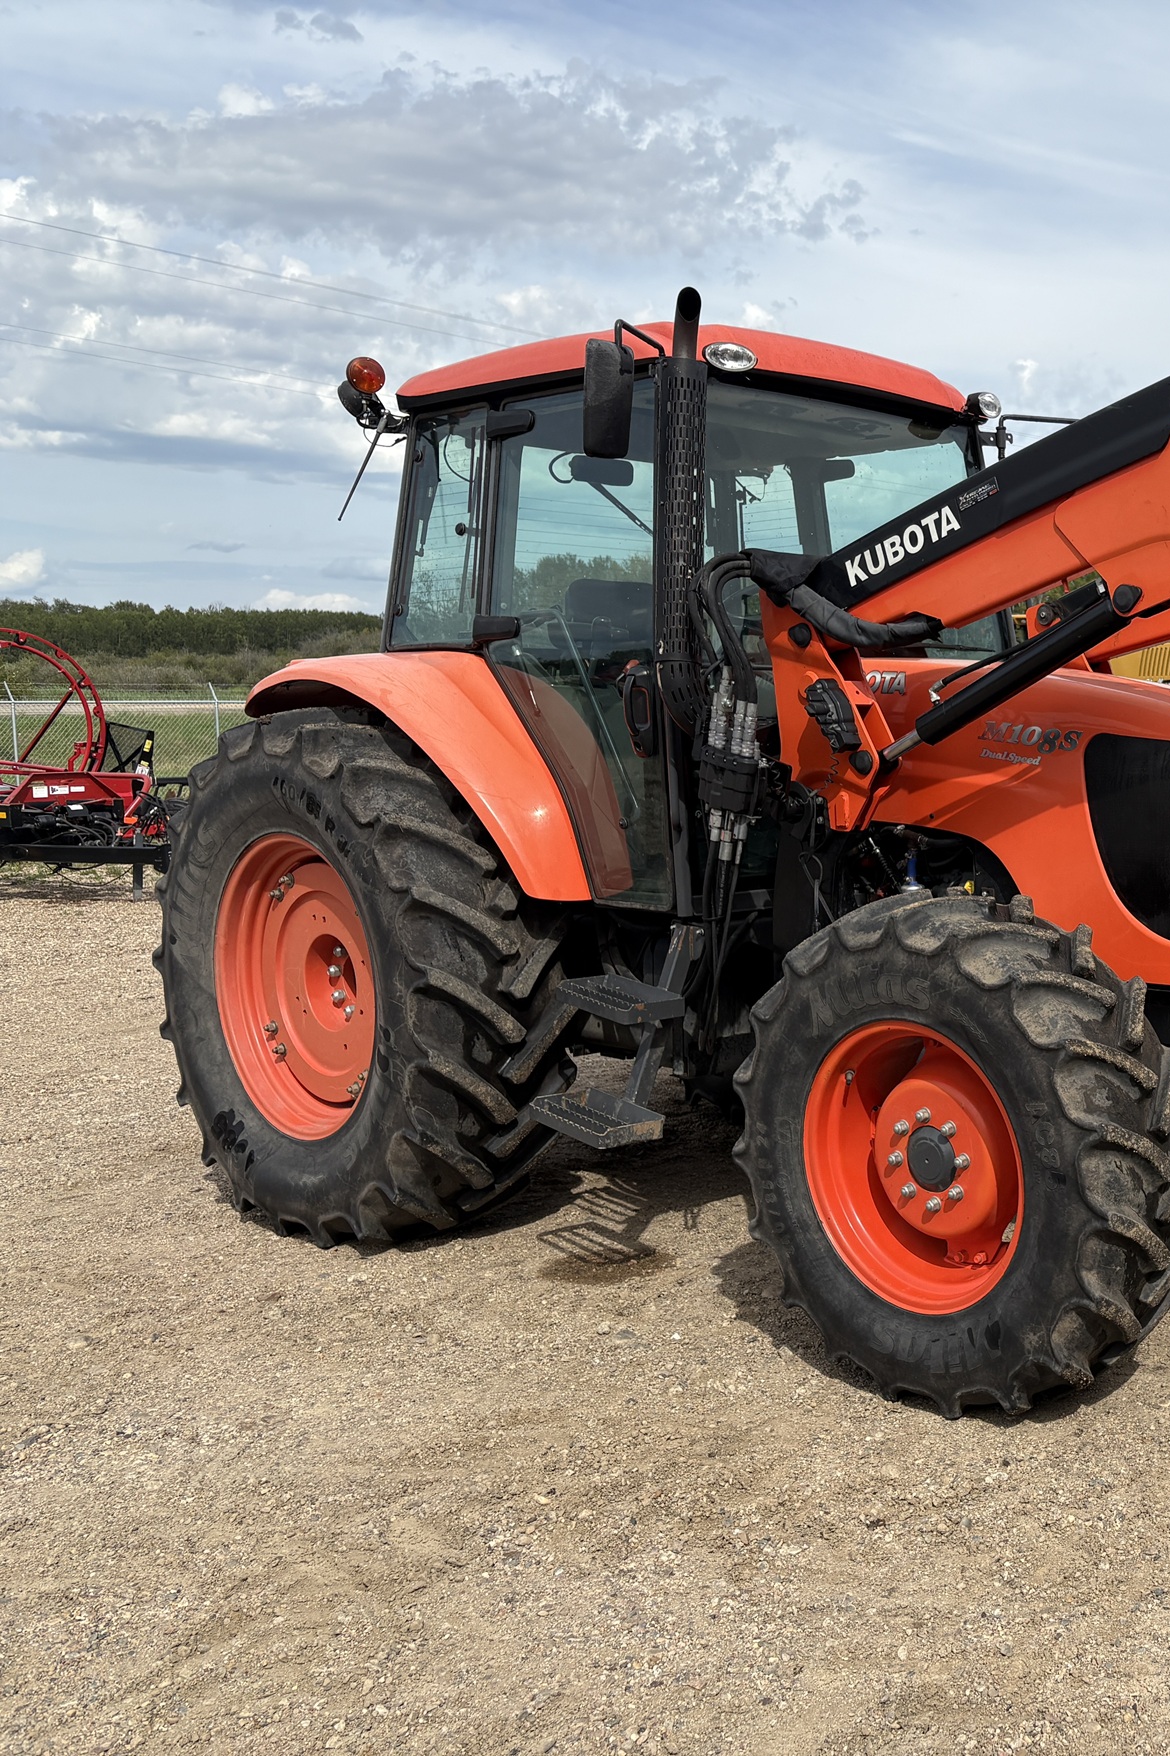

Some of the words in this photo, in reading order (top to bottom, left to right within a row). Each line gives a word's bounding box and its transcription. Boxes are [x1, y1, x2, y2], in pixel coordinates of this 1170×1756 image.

[845, 505, 961, 588] KUBOTA
[978, 721, 1084, 755] M108S
[980, 748, 1008, 760] Dual
[1008, 752, 1042, 766] Speed
